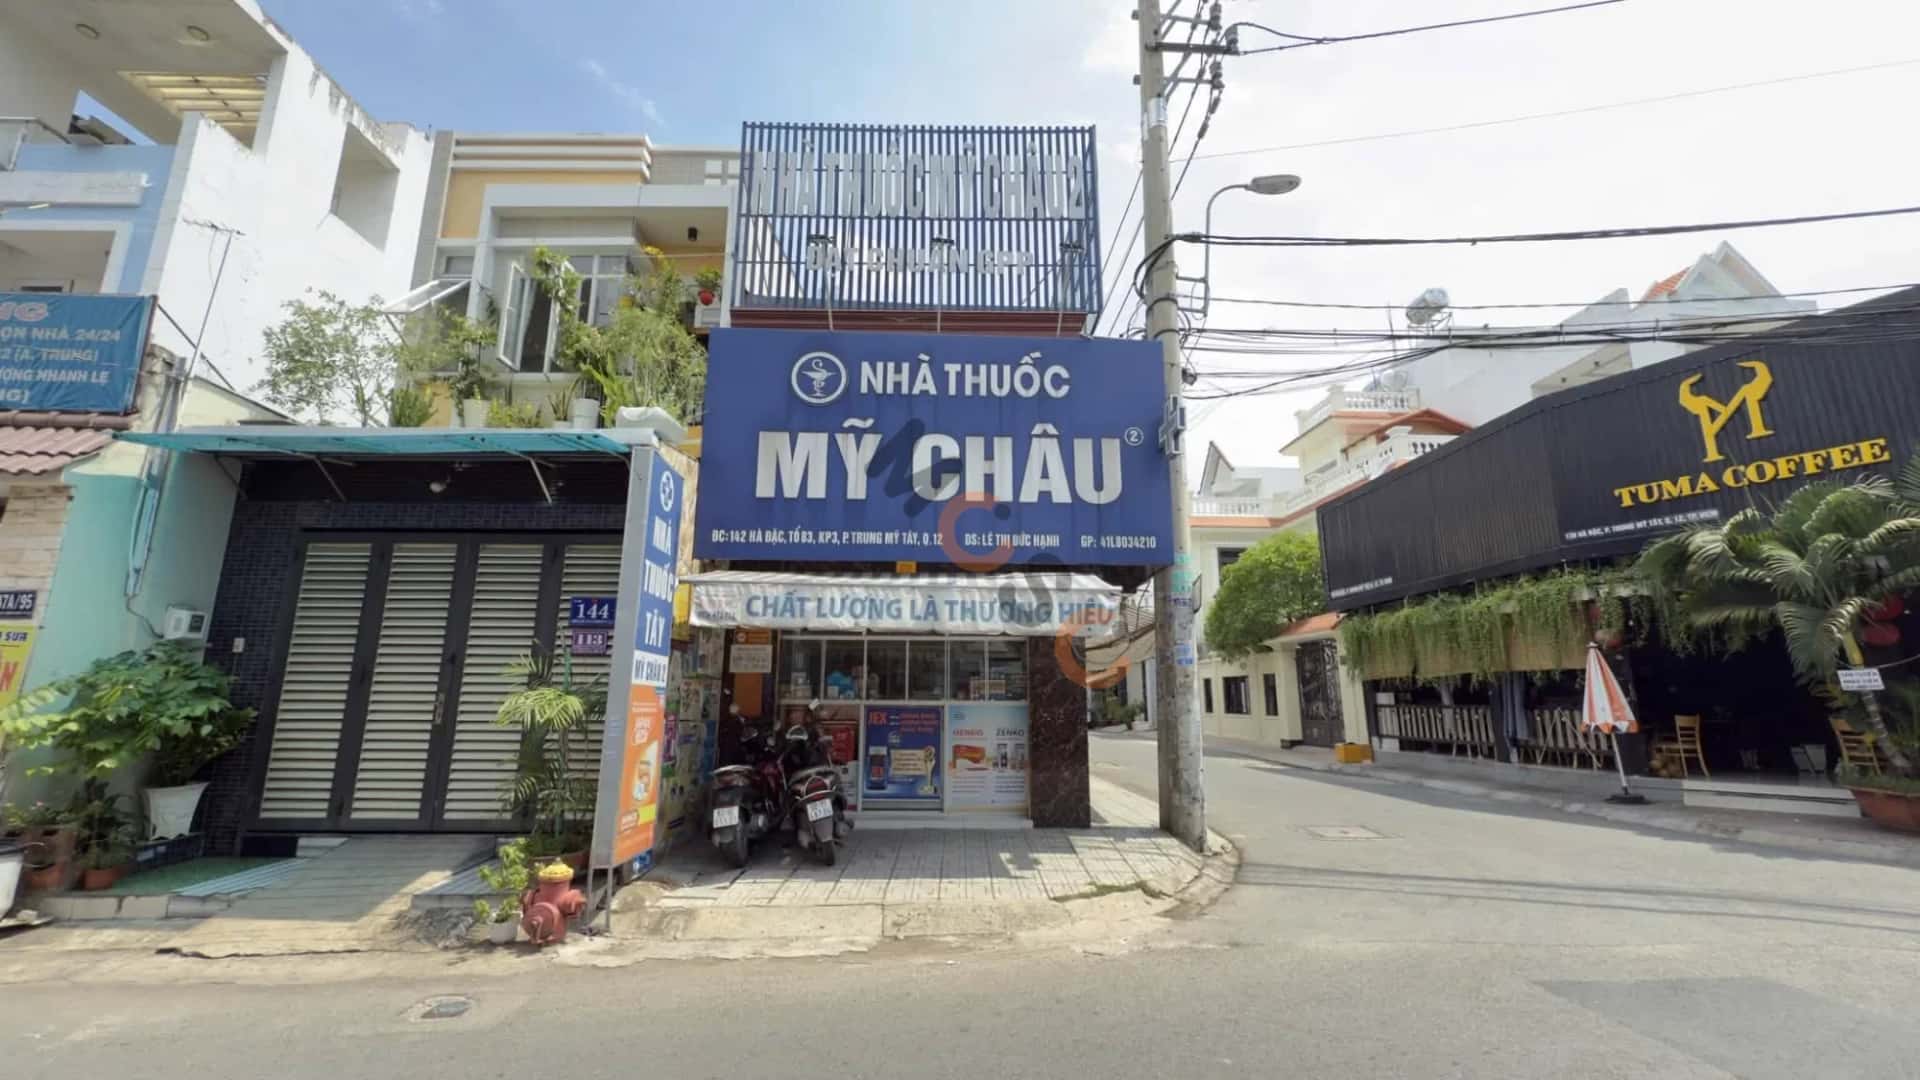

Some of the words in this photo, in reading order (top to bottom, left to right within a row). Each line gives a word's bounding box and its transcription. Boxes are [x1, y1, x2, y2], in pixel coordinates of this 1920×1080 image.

[1067, 154, 1086, 219] 2
[977, 250, 1034, 275] GPP
[35, 368, 87, 384] NHANH
[859, 353, 937, 396] NHÀ
[944, 351, 1071, 399] THUỐC
[755, 417, 883, 500] MỸ
[912, 422, 1122, 505] CHÂU
[1614, 471, 1720, 508] TUMA
[1722, 437, 1892, 488] COFFEE
[851, 532, 883, 545] TRUNG
[576, 603, 609, 619] 144
[745, 590, 811, 618] CHẤT
[815, 593, 904, 625] LƯỢNG
[910, 595, 939, 621] LÀ
[944, 598, 1053, 624] THƯƠNG
